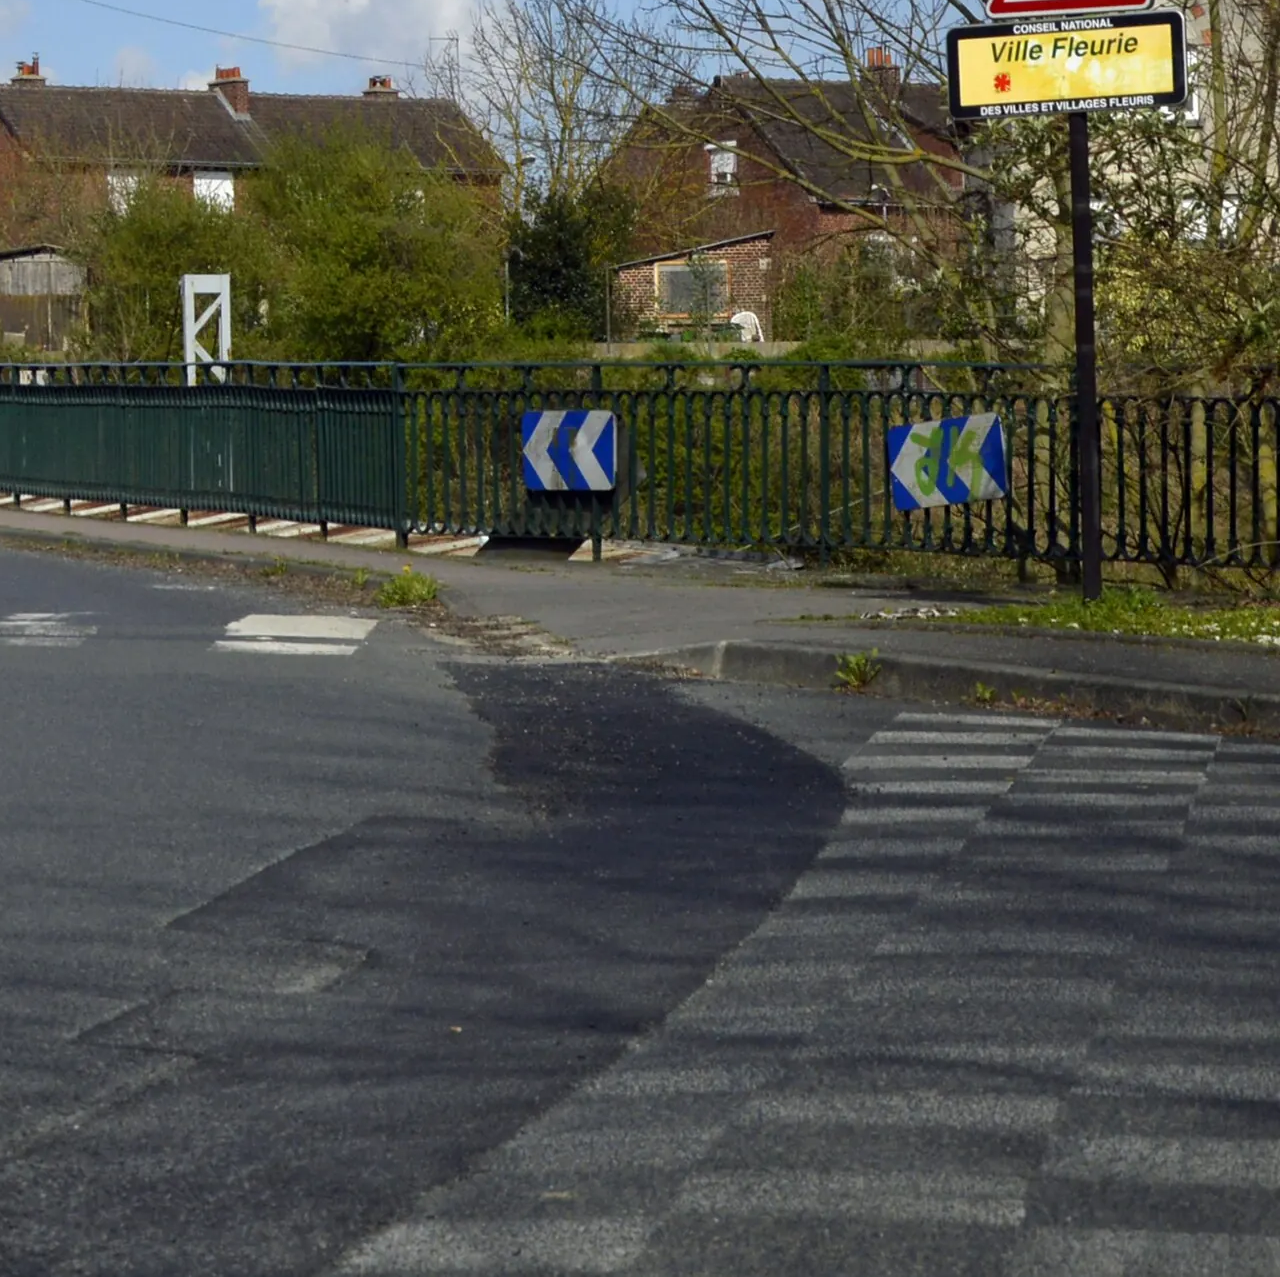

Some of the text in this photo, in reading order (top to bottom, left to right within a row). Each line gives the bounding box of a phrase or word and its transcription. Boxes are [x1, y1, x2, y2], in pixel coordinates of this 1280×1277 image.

[1013, 18, 1114, 35] CONSEIL NATIONAL
[991, 32, 1139, 63] Ville Fleurie
[980, 94, 1155, 117] DES VILLES ET VILLAGES FLEURIS
